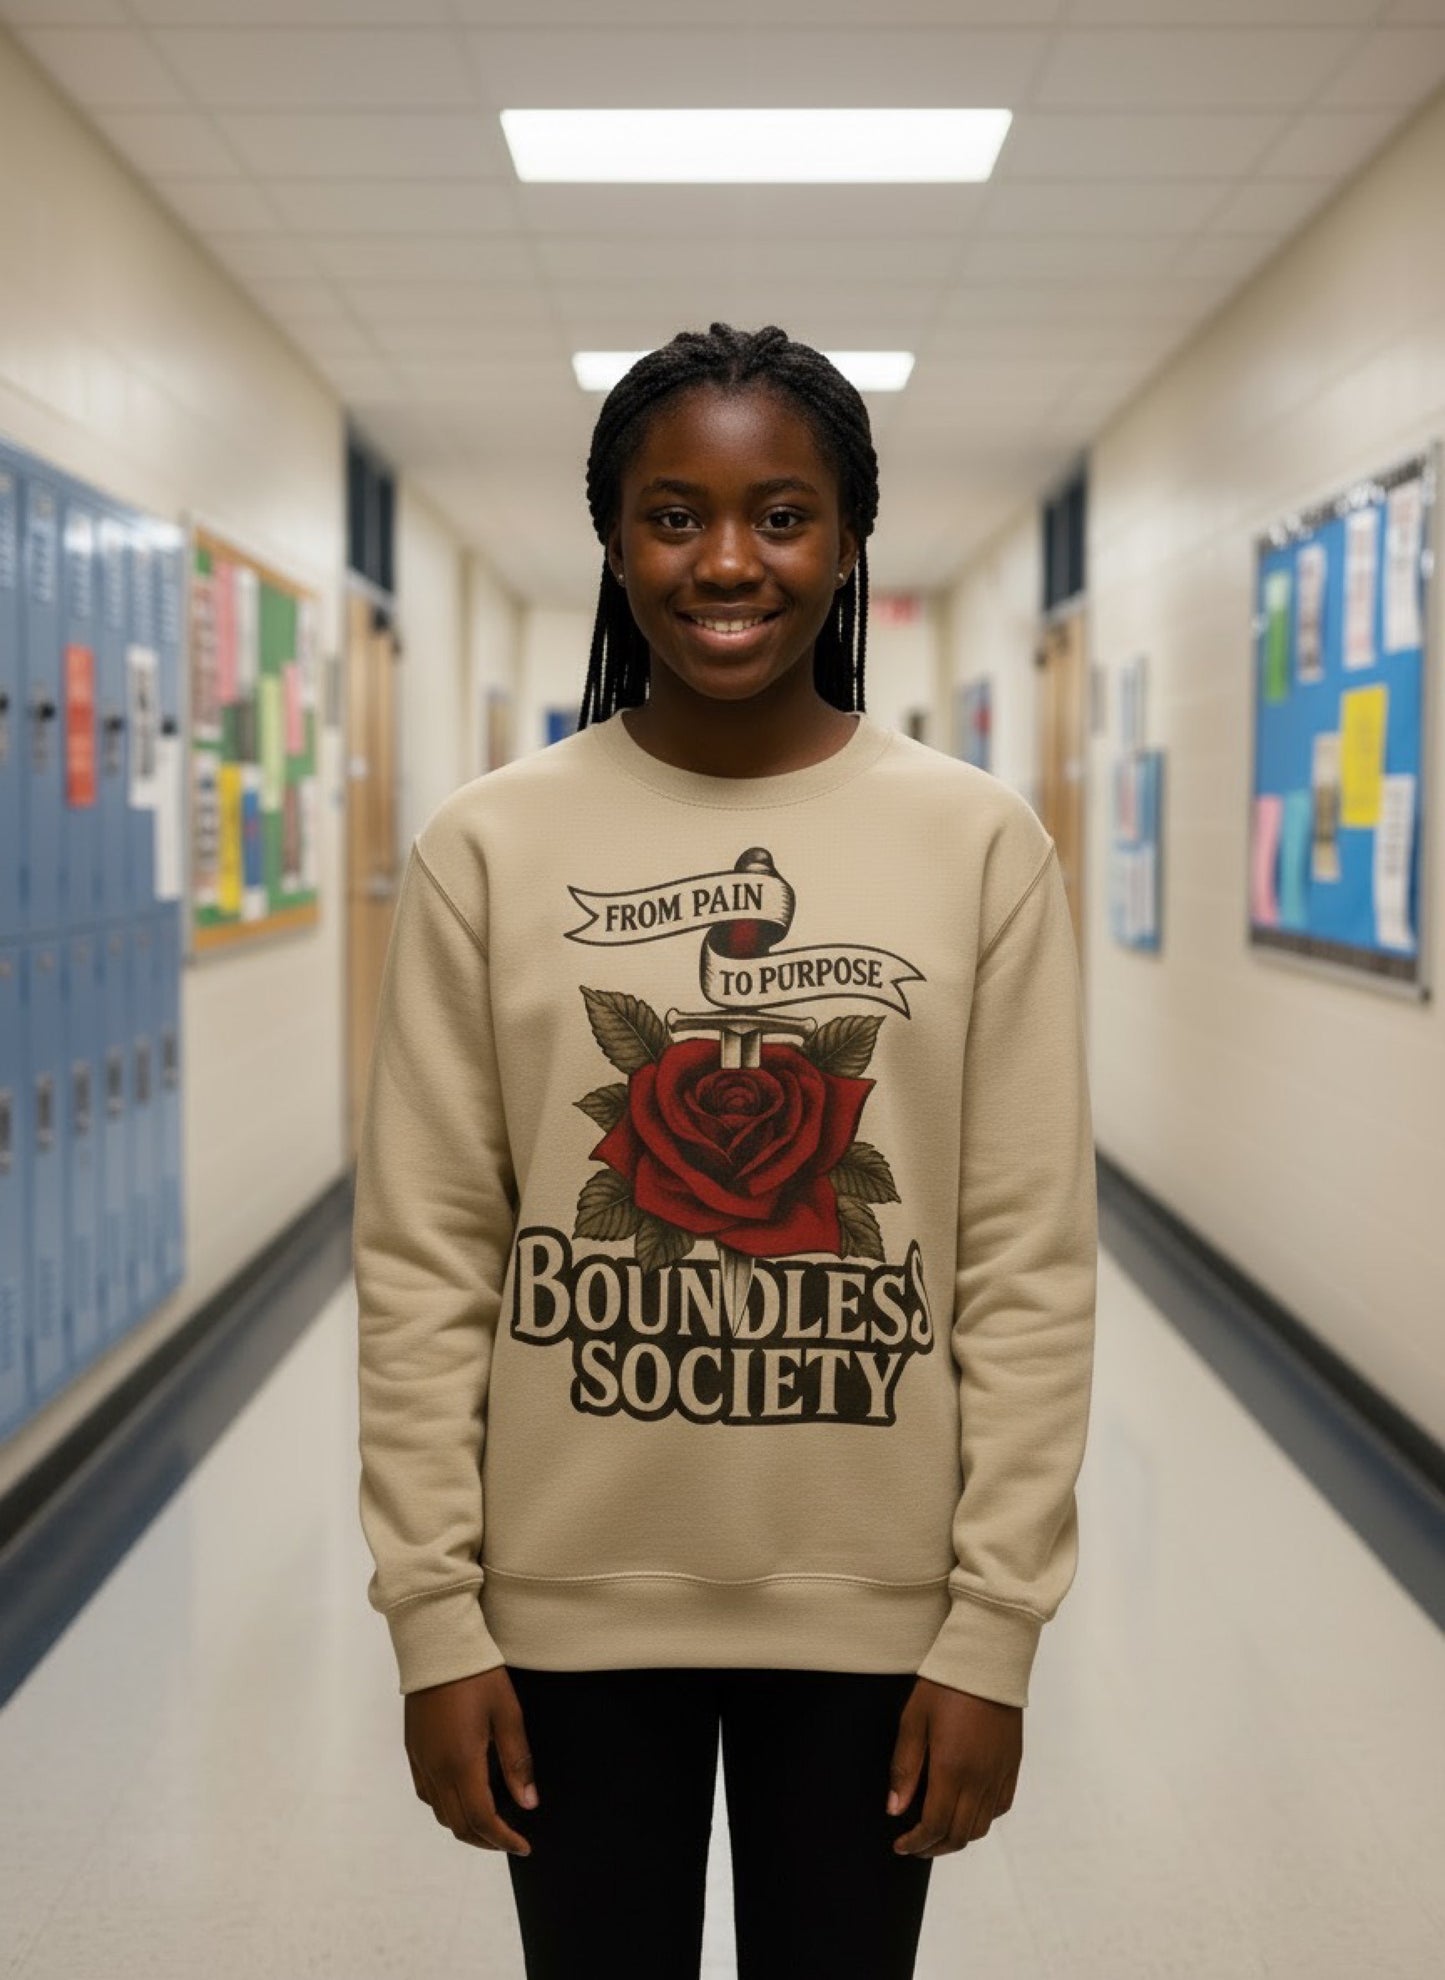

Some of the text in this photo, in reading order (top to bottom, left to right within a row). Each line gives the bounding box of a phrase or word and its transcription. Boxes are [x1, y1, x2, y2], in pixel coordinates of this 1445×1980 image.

[604, 883, 764, 932] FROM PAIN
[719, 957, 883, 996] TO PURPOSE
[513, 1233, 934, 1348] BOUNDLESS
[579, 1340, 902, 1419] SOCIETY
